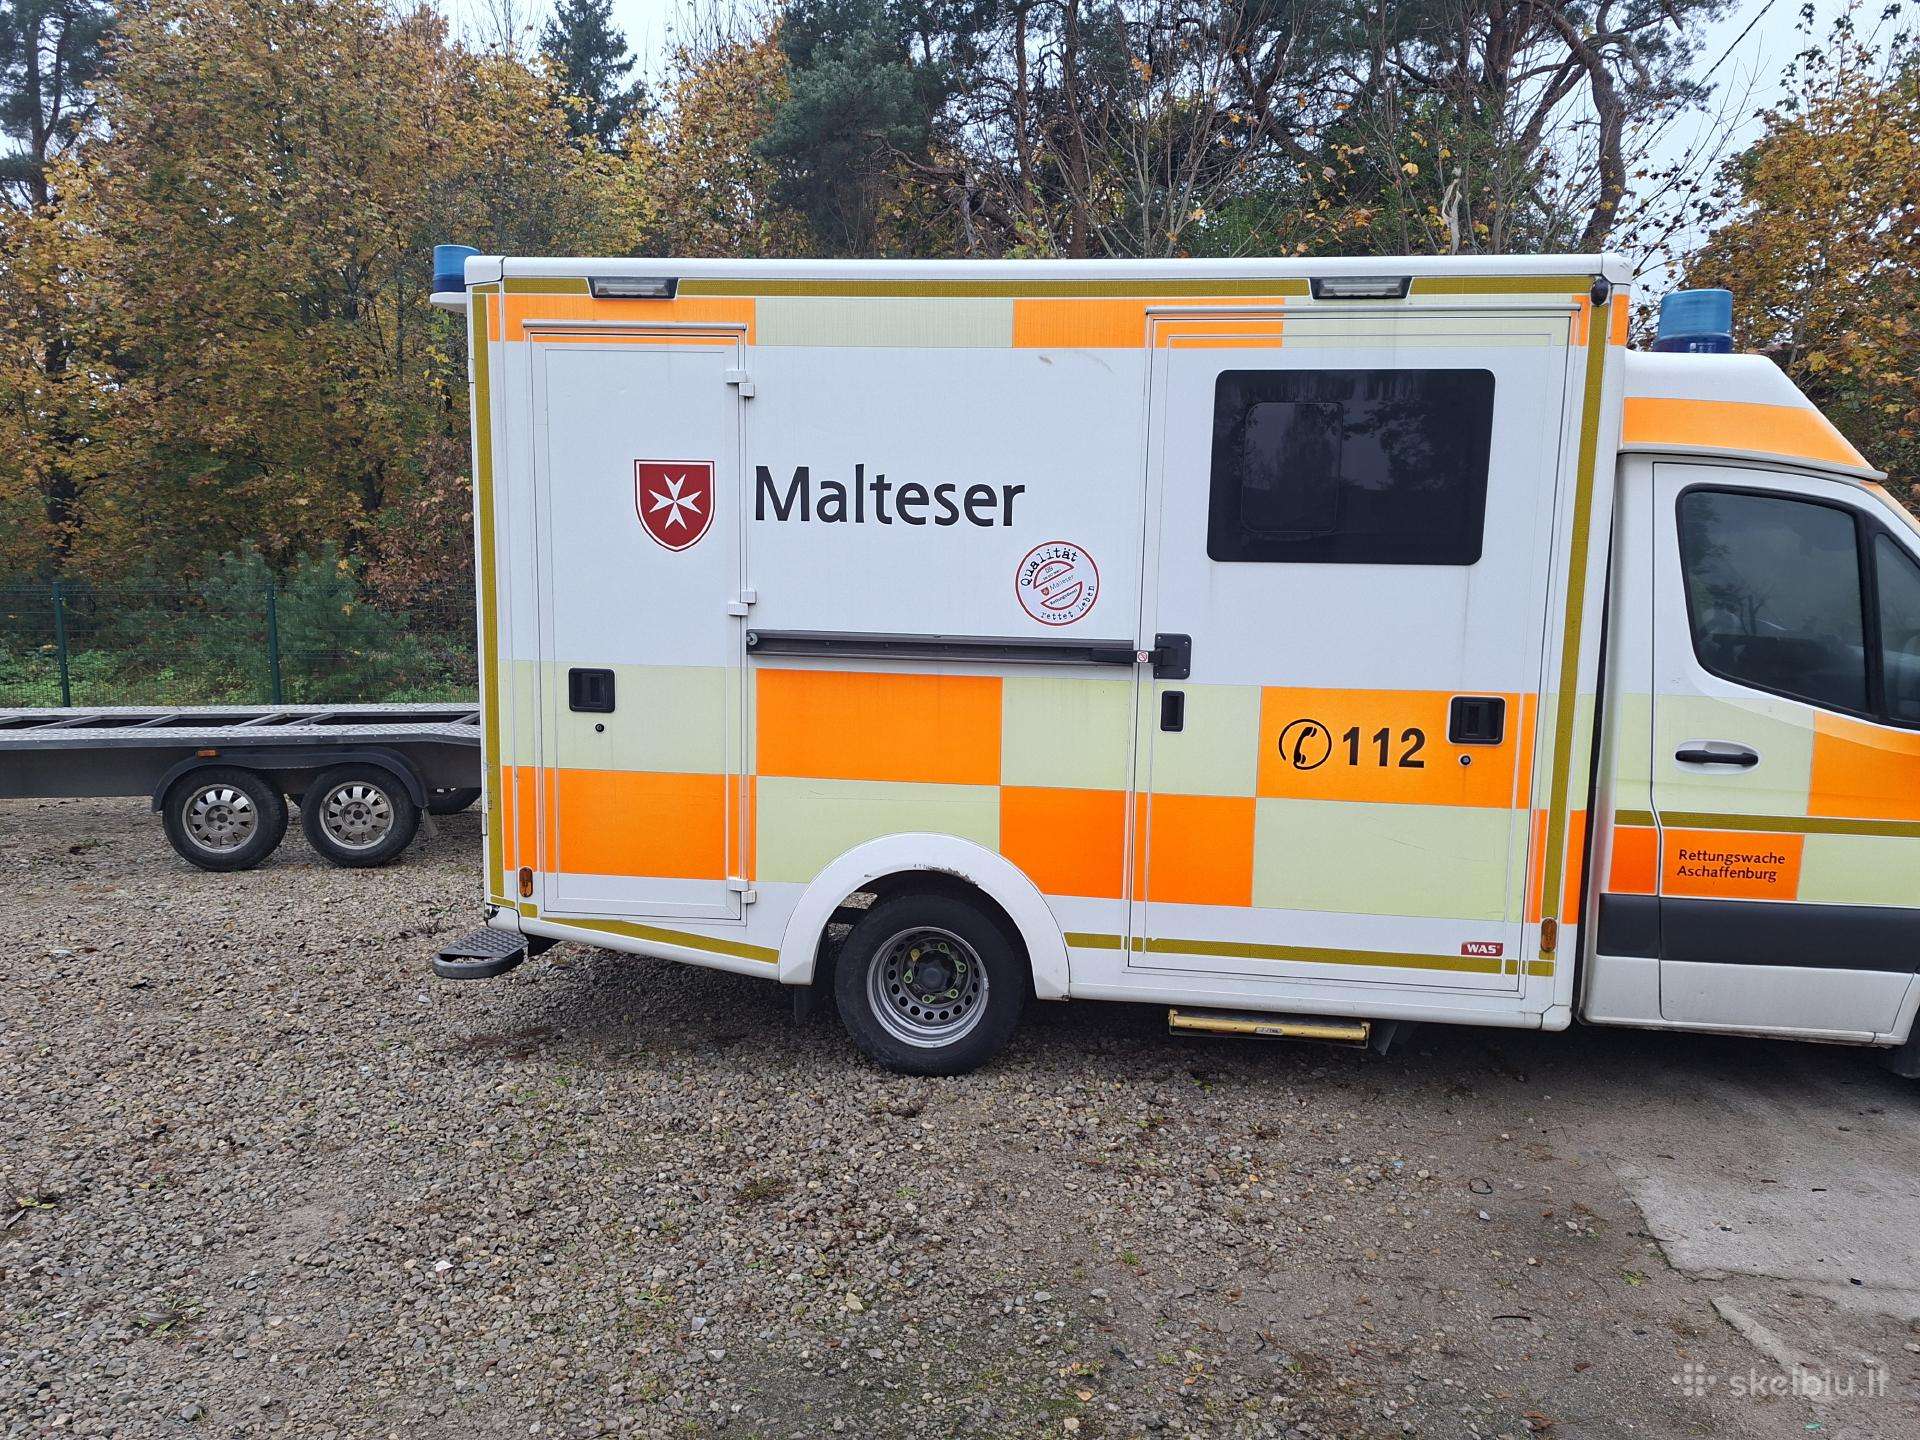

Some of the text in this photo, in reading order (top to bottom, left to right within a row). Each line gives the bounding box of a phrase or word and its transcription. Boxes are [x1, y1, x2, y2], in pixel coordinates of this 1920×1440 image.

[755, 463, 1026, 527] Malteser
[1020, 547, 1078, 586] Qualität
[1342, 726, 1426, 768] 112
[1678, 849, 1786, 866] Rettungswache
[1677, 865, 1778, 883] Aschaffenburg
[1466, 943, 1497, 954] WAS
